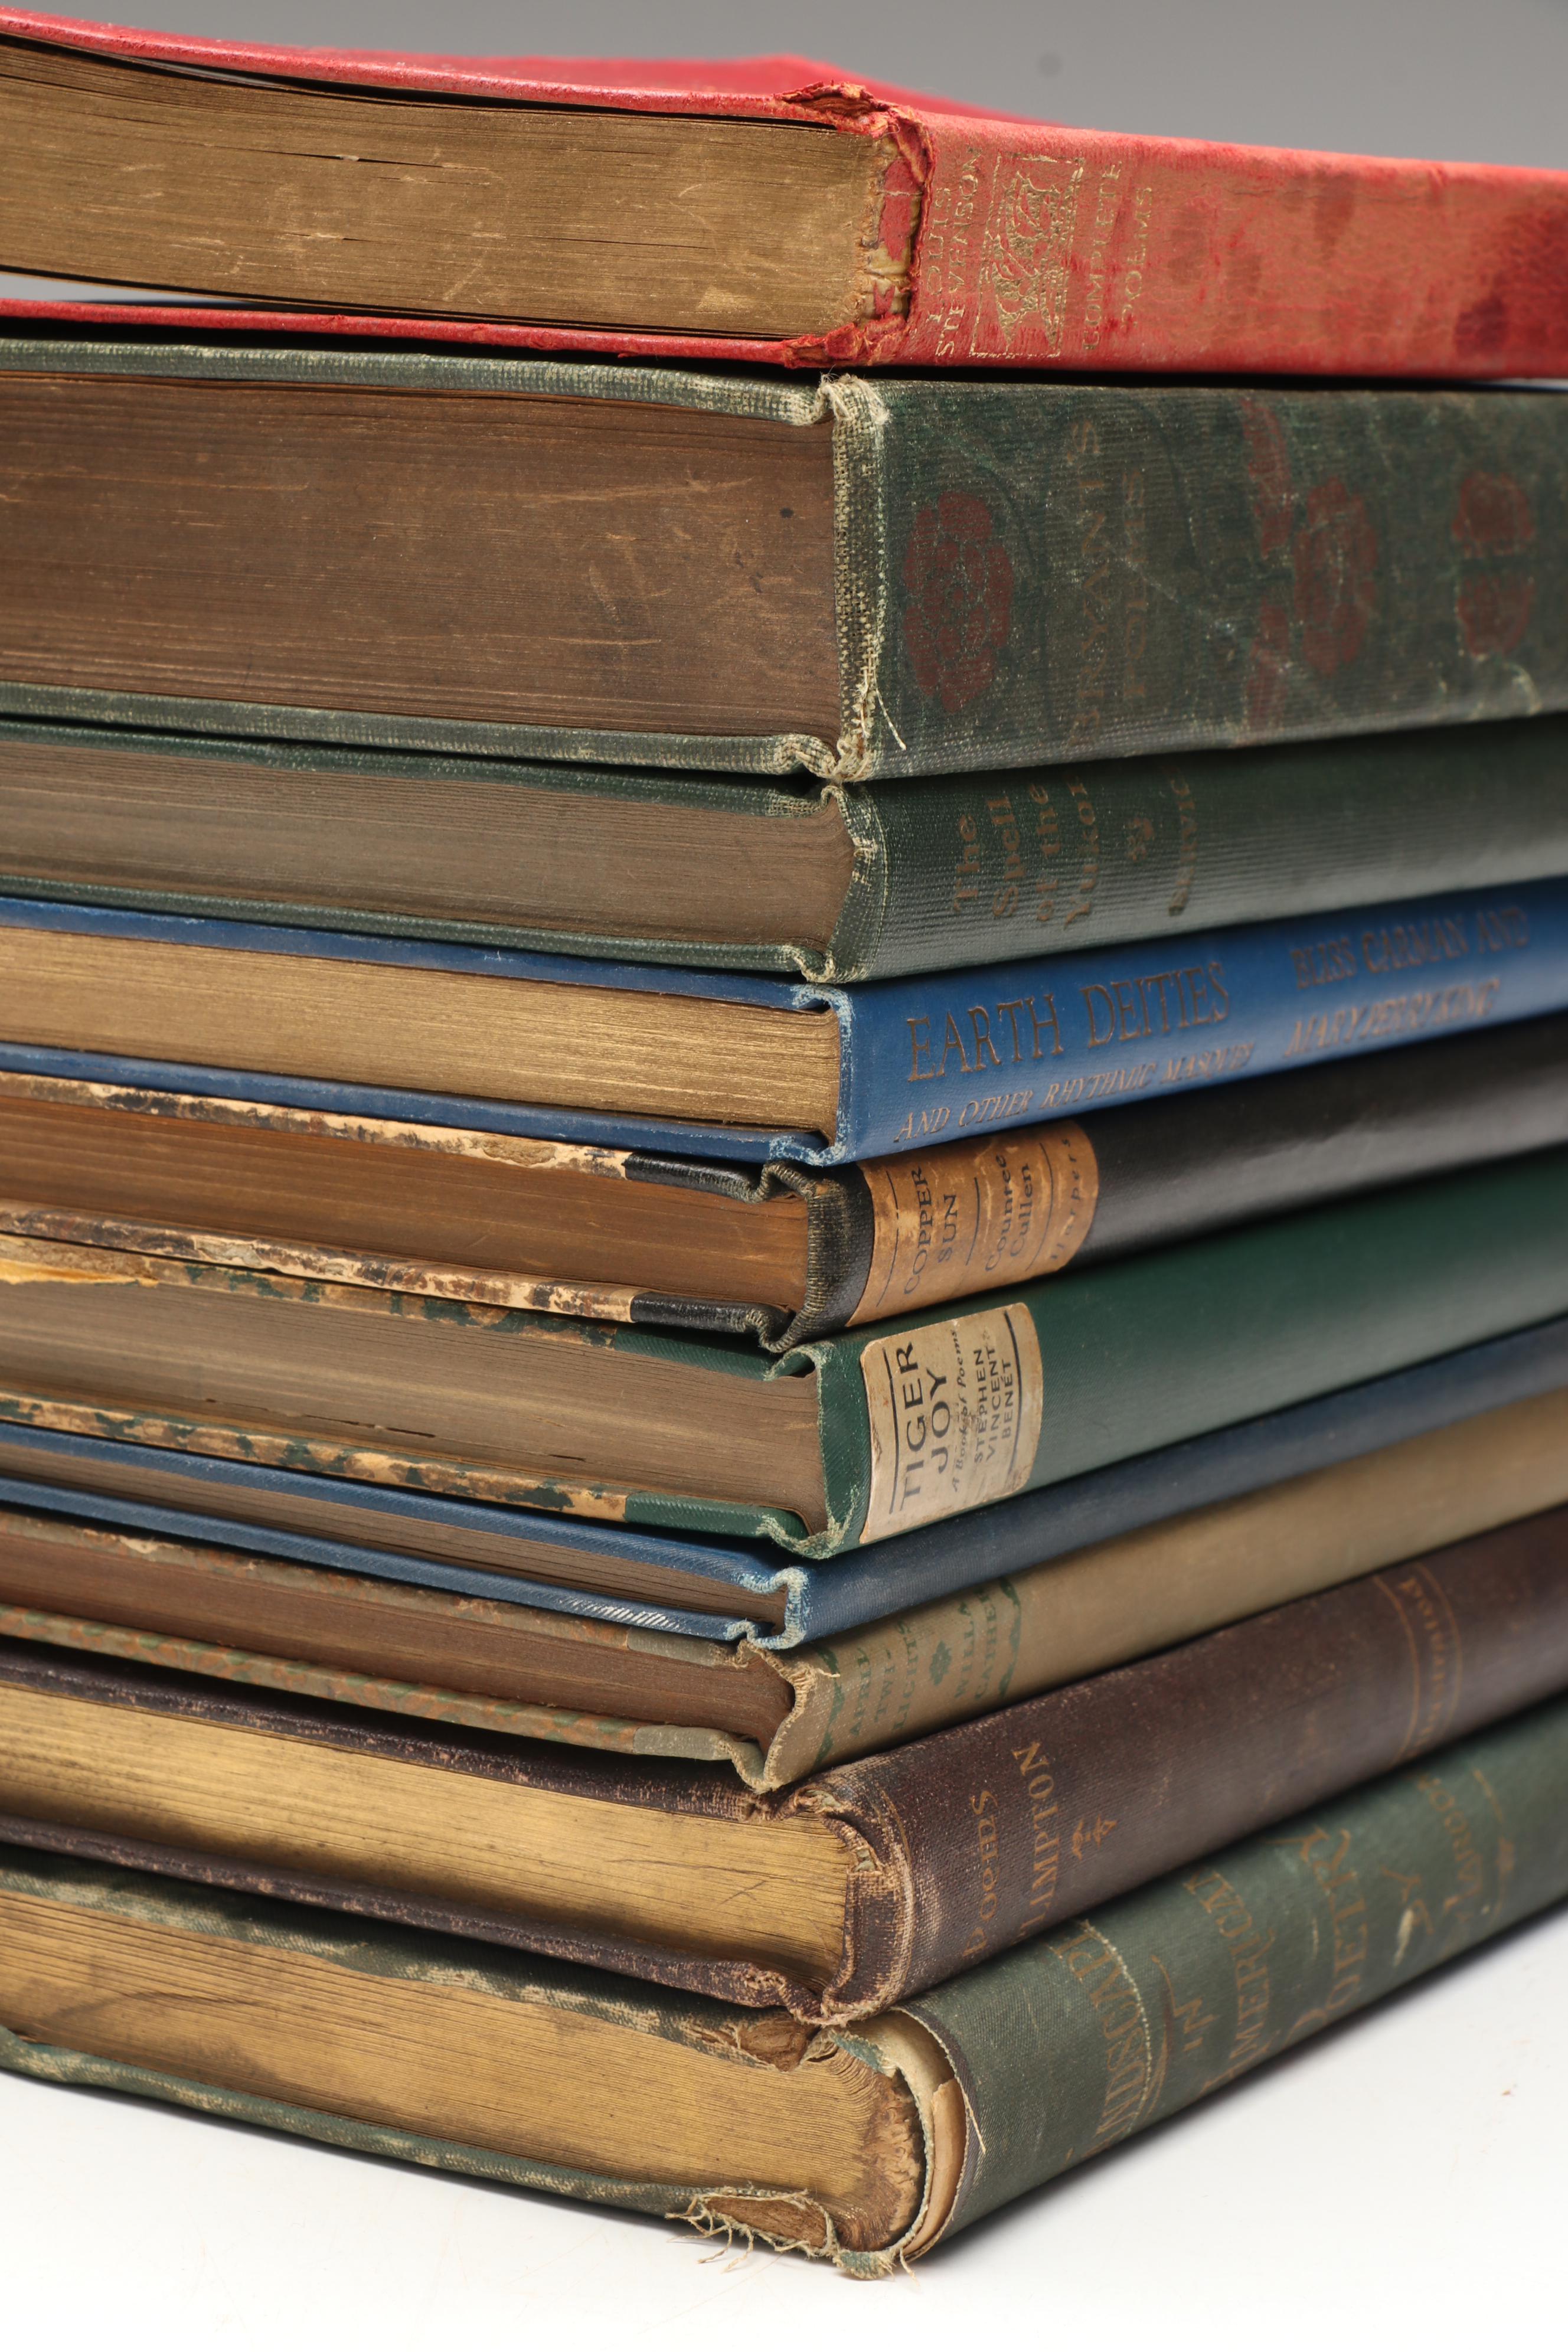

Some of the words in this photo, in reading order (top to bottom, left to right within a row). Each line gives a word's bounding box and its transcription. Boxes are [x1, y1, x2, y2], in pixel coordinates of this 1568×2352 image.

[926, 187, 951, 324] LOUIS
[1082, 161, 1122, 351] COMPLETE
[1121, 468, 1148, 698] POEMS
[953, 814, 981, 913] The
[986, 796, 1025, 917] Spell
[1029, 782, 1061, 858] the
[907, 992, 1063, 1083] EARTH
[1079, 961, 1230, 1048] DEITIES
[1290, 936, 1357, 989] BLISS
[1363, 916, 1469, 974] CARMAN
[1477, 906, 1530, 954] AND
[893, 1107, 950, 1143] AND
[959, 1090, 1033, 1127] OTHER
[1039, 1063, 1157, 1109] RHYTHMIC
[1284, 1005, 1367, 1058] MARY
[1435, 977, 1501, 1025] KING
[903, 1166, 933, 1295] COPPER
[937, 1194, 958, 1263] SUN
[985, 1154, 1014, 1271] Countee
[1010, 1162, 1034, 1257] Cullen
[950, 1329, 966, 1388] Poems
[958, 1393, 968, 1417] of
[974, 1349, 988, 1464] STEPHEN
[985, 1345, 1001, 1462] VINCENT
[896, 1341, 926, 1511] TIGER
[926, 1367, 950, 1474] JOY
[955, 1426, 968, 1470] Book
[952, 1477, 960, 1493] A
[850, 1648, 871, 1736] APRIL
[893, 1619, 917, 1732] LIGHTS
[955, 1602, 975, 1699] WILLA
[1011, 1740, 1061, 1942] LIMPTON
